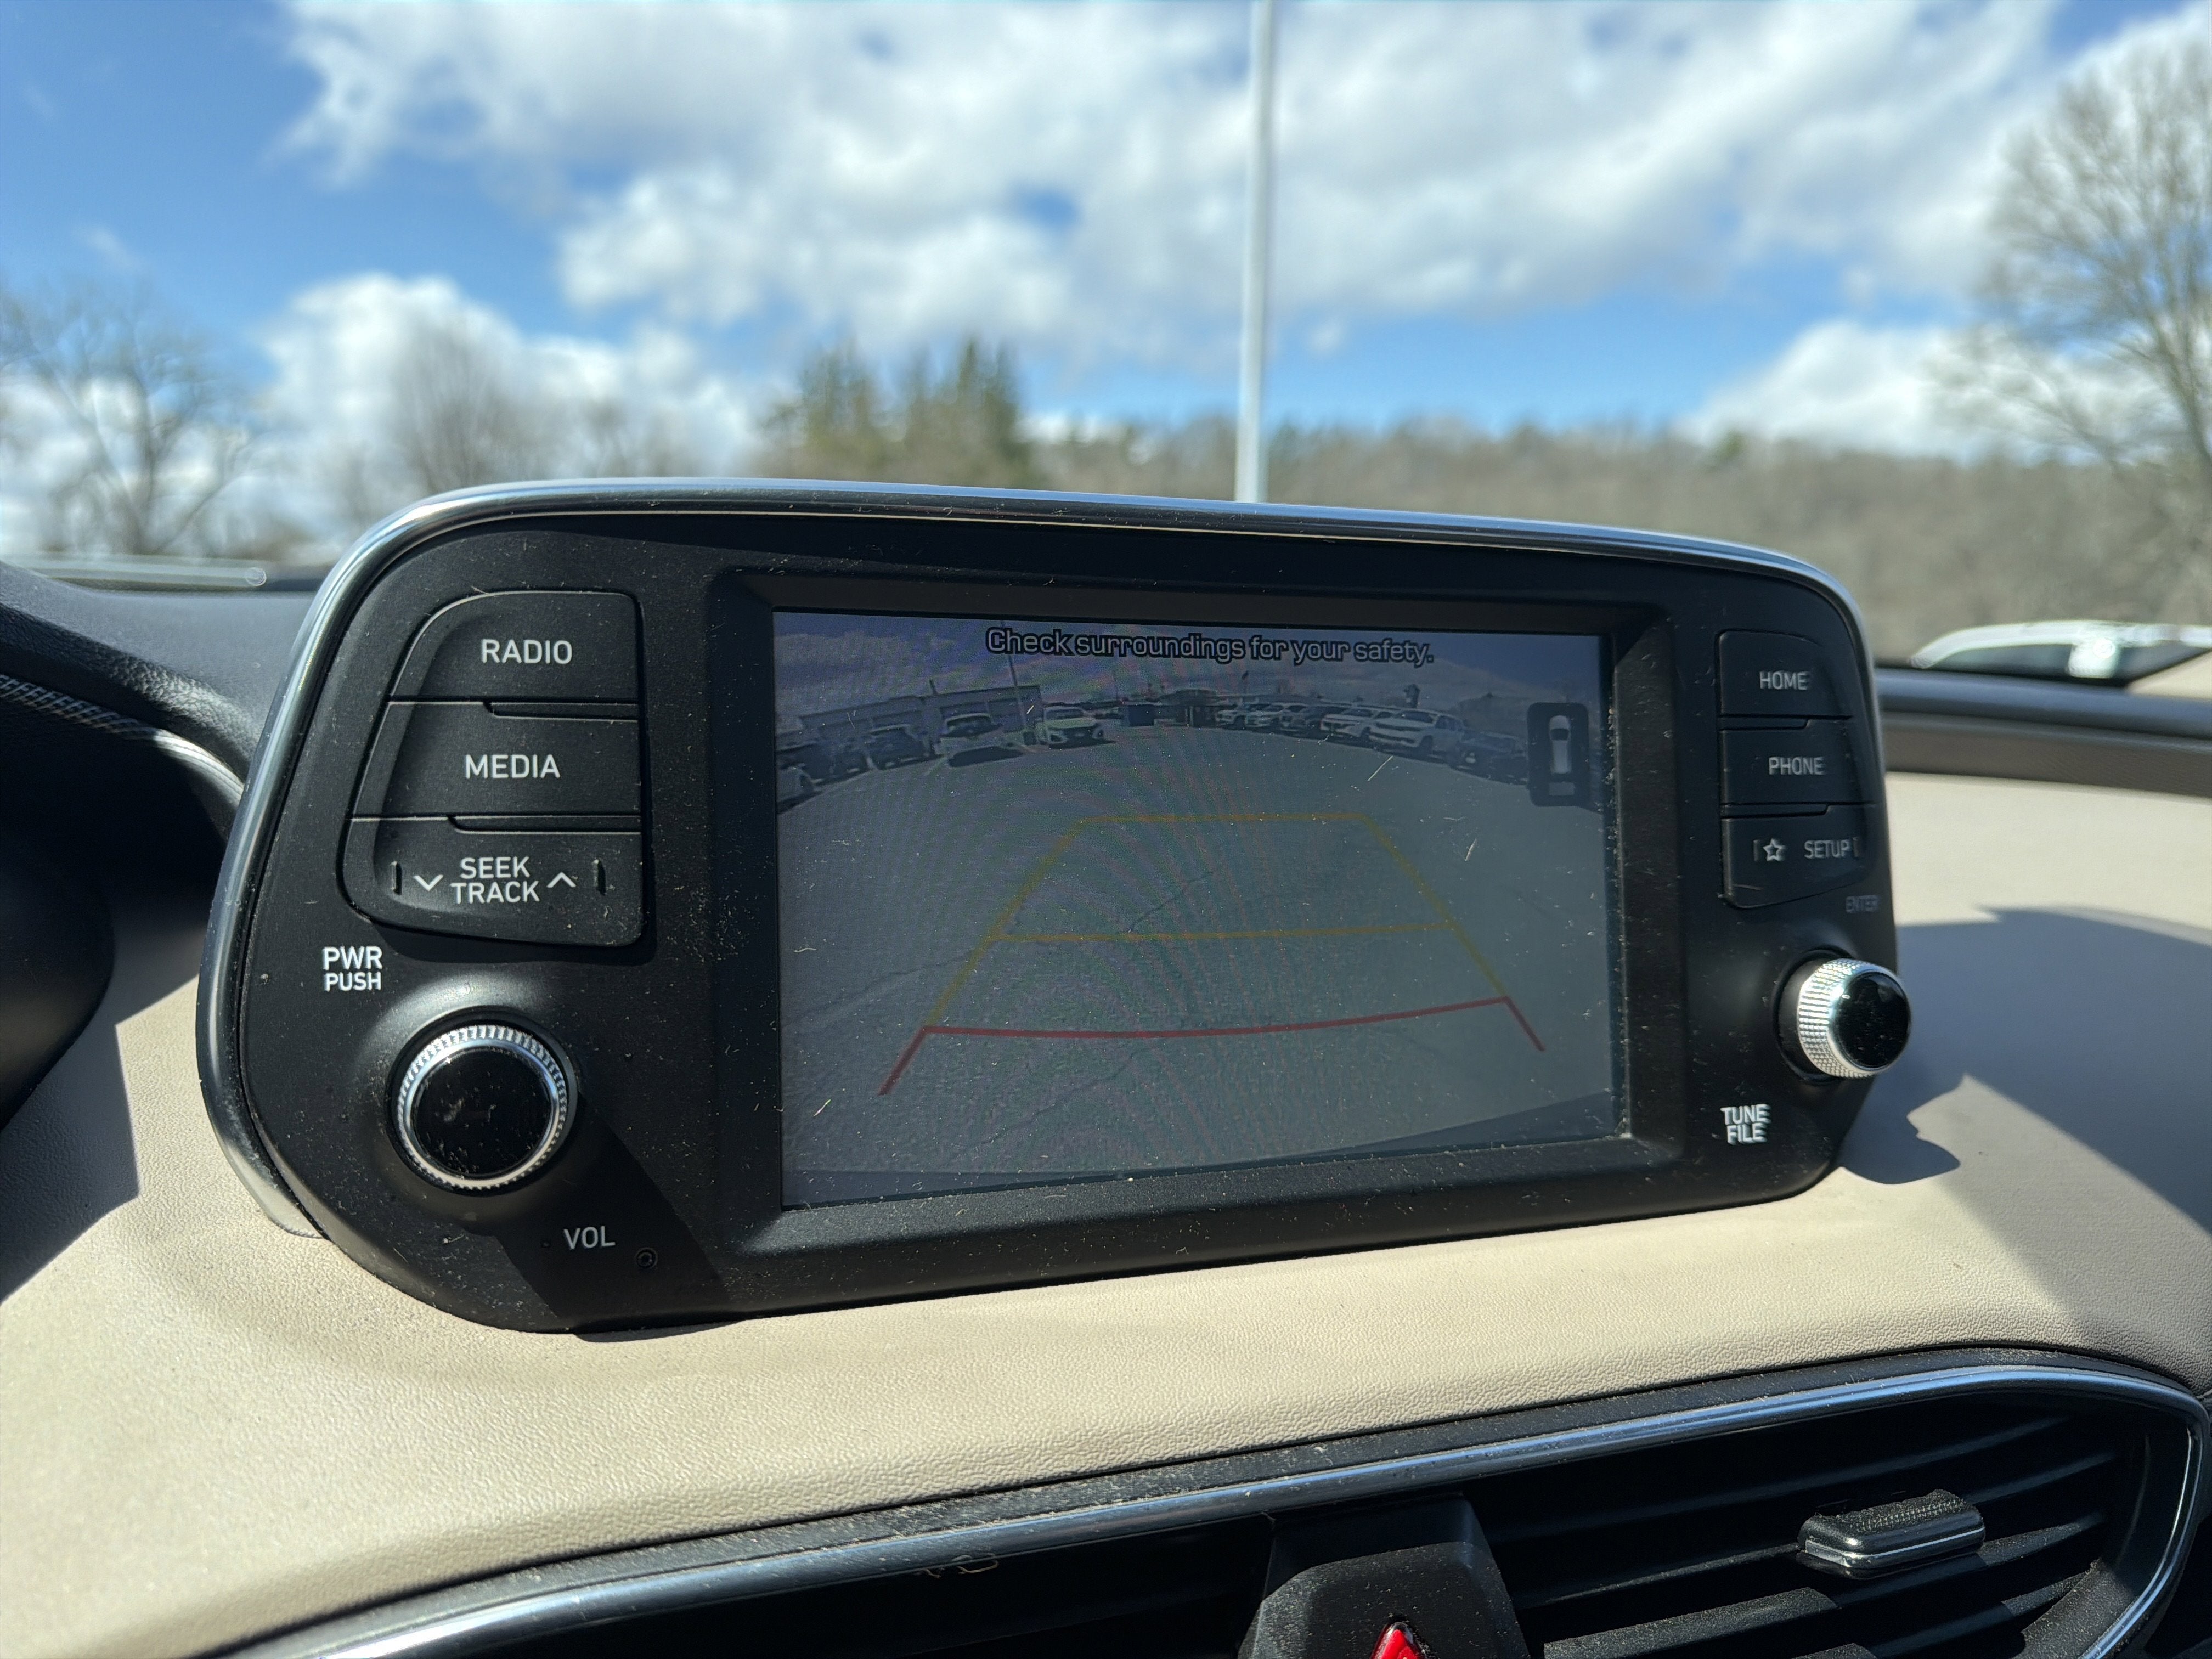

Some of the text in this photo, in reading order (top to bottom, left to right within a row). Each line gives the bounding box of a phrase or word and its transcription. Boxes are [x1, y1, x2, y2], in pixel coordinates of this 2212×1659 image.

[482, 639, 573, 664] RADIO
[987, 628, 1434, 668] Check surroundings for your safety.
[1759, 670, 1809, 690] HOME
[465, 754, 561, 779] MEDIA
[1769, 756, 1825, 775] PHONE
[1804, 839, 1852, 859] SETUP
[460, 856, 531, 879] SEEK
[450, 881, 540, 904] TRACK
[322, 945, 383, 970] PWR
[324, 971, 381, 992] PUSH
[1720, 1104, 1771, 1125] TUNE
[1726, 1122, 1768, 1146] FILE
[563, 1226, 616, 1250] VOL
